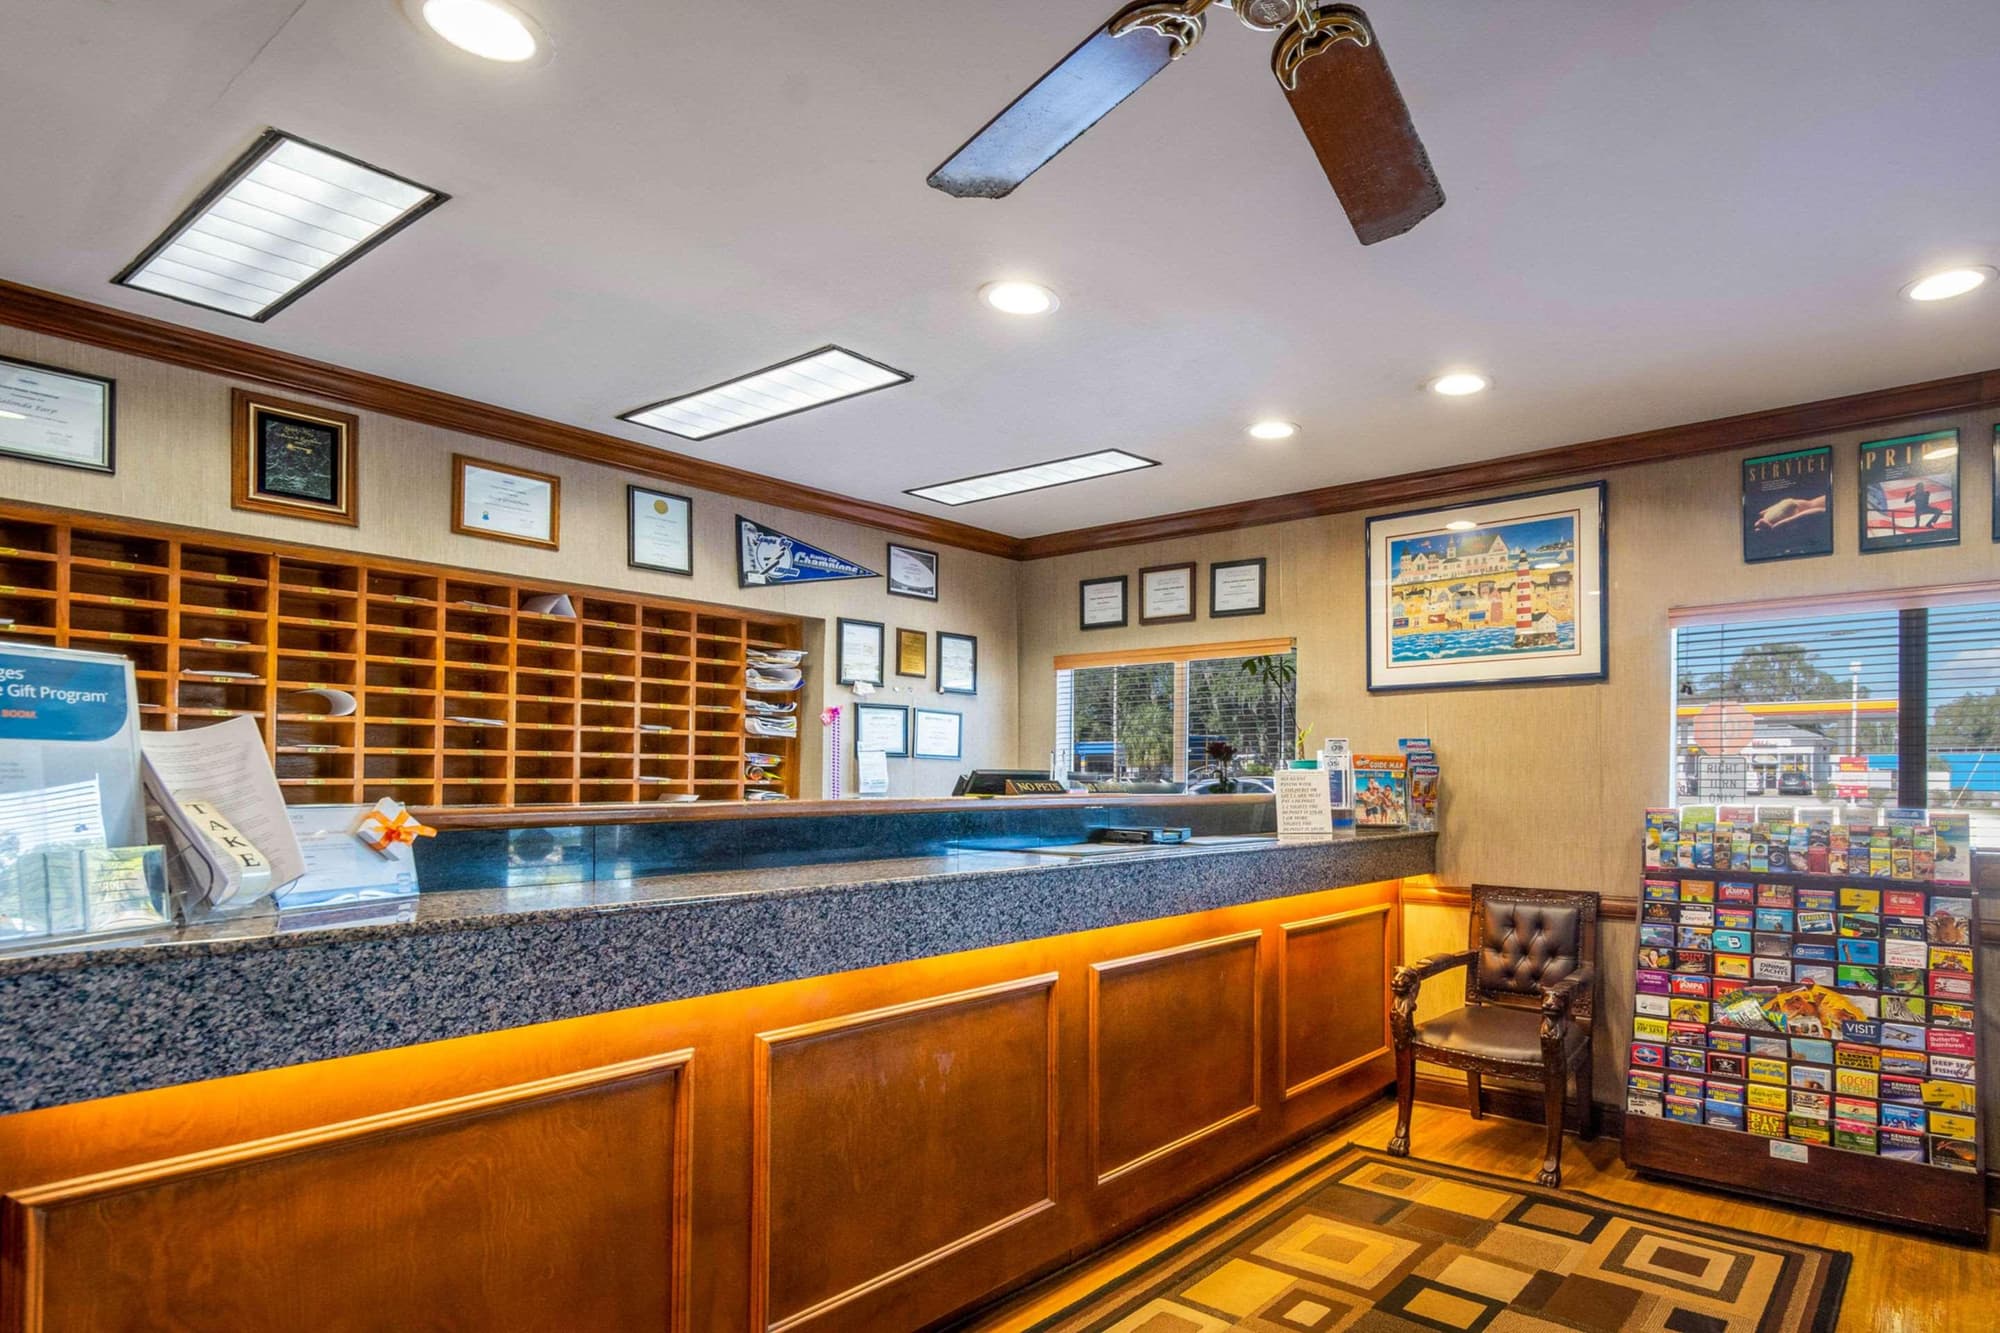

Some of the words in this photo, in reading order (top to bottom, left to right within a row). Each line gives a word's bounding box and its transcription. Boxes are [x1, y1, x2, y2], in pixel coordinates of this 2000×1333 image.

[1750, 456, 1825, 481] SERVICE
[7, 684, 37, 698] Gift
[40, 686, 106, 703] Program
[1706, 763, 1737, 774] RIGHT
[1017, 782, 1033, 792] NO
[1710, 779, 1737, 789] TURN
[185, 803, 262, 868] TAKE
[1845, 1023, 1876, 1034] VISIT
[1932, 1059, 1954, 1067] DEEP
[1751, 1112, 1779, 1125] BIG
